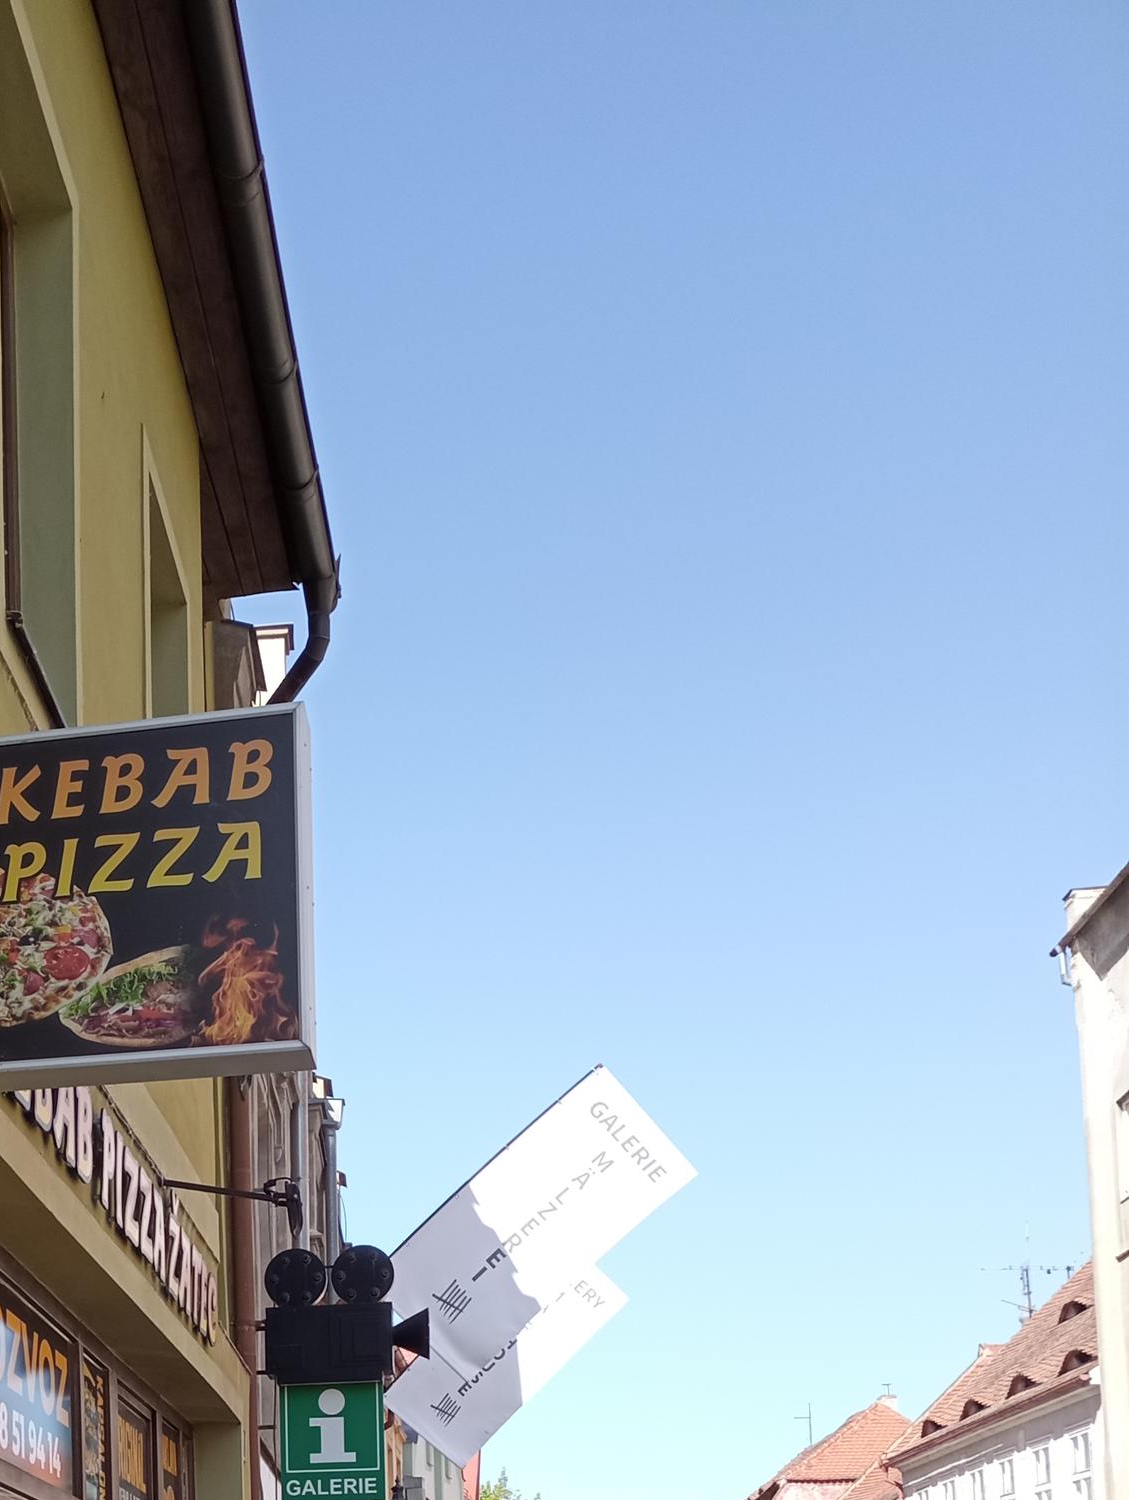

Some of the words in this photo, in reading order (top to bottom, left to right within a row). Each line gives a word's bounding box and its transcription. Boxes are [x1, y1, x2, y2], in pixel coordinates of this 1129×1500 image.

[2, 821, 262, 902] PIZZA
[589, 1100, 667, 1184] GALERIE
[101, 1108, 167, 1284] PIZZA
[168, 1189, 217, 1347] ŽATEC
[572, 1279, 606, 1309] ERY
[12, 1409, 25, 1459] 51
[28, 1420, 45, 1470] 94
[48, 1432, 61, 1478] 14
[286, 1477, 377, 1496] GALERIE
